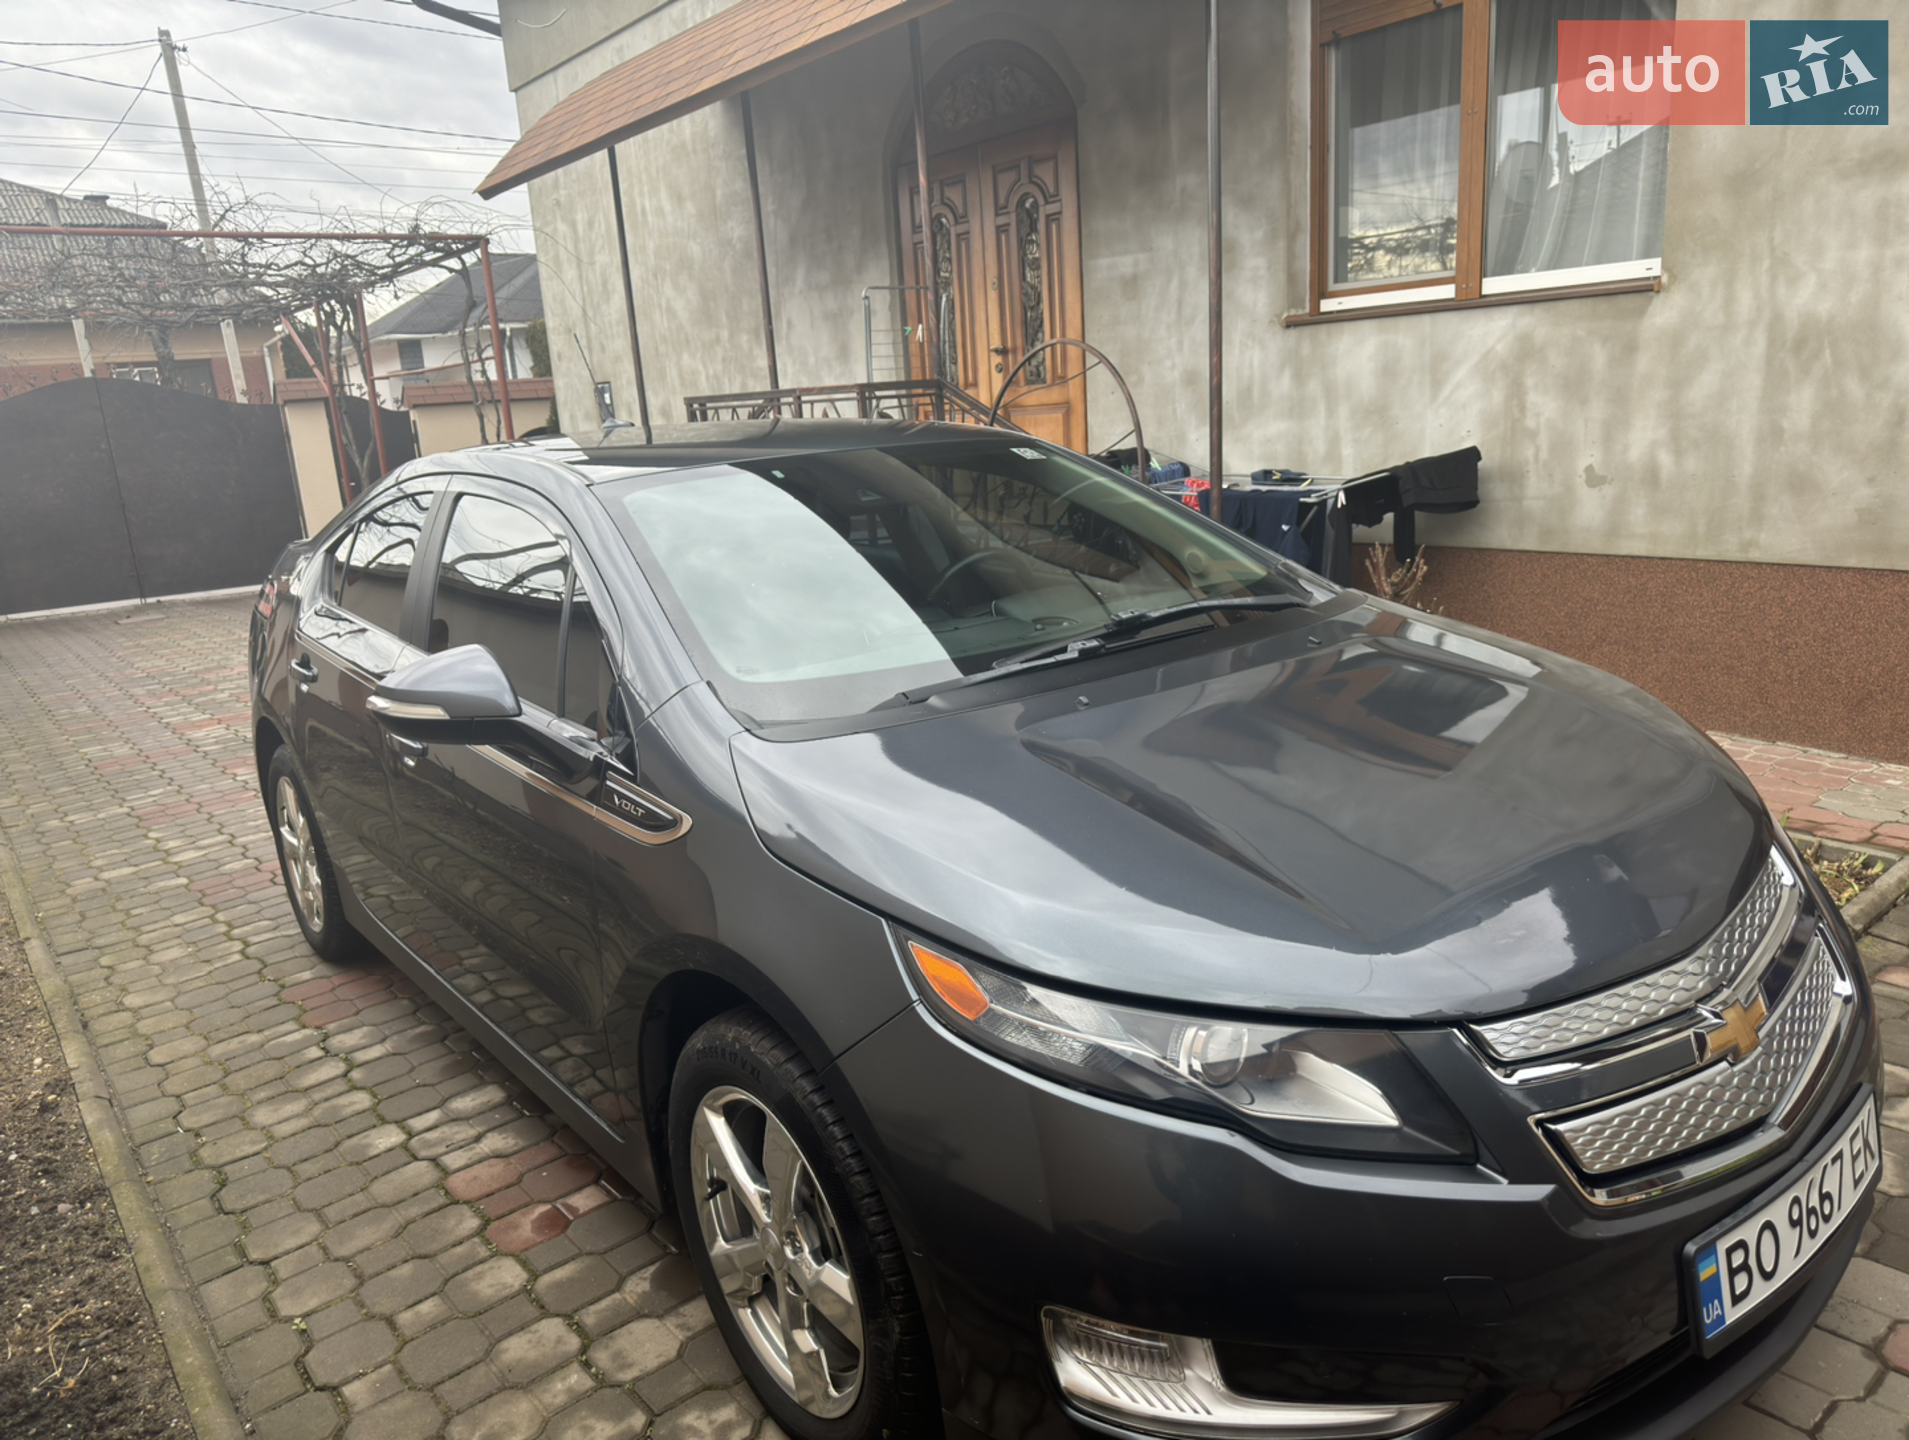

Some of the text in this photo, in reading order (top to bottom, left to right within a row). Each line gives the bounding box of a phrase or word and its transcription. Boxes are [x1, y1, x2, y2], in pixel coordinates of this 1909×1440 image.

[613, 793, 646, 817] VOLT
[1725, 1107, 1875, 1307] BO 9667 EK
[1703, 1299, 1722, 1324] UA
